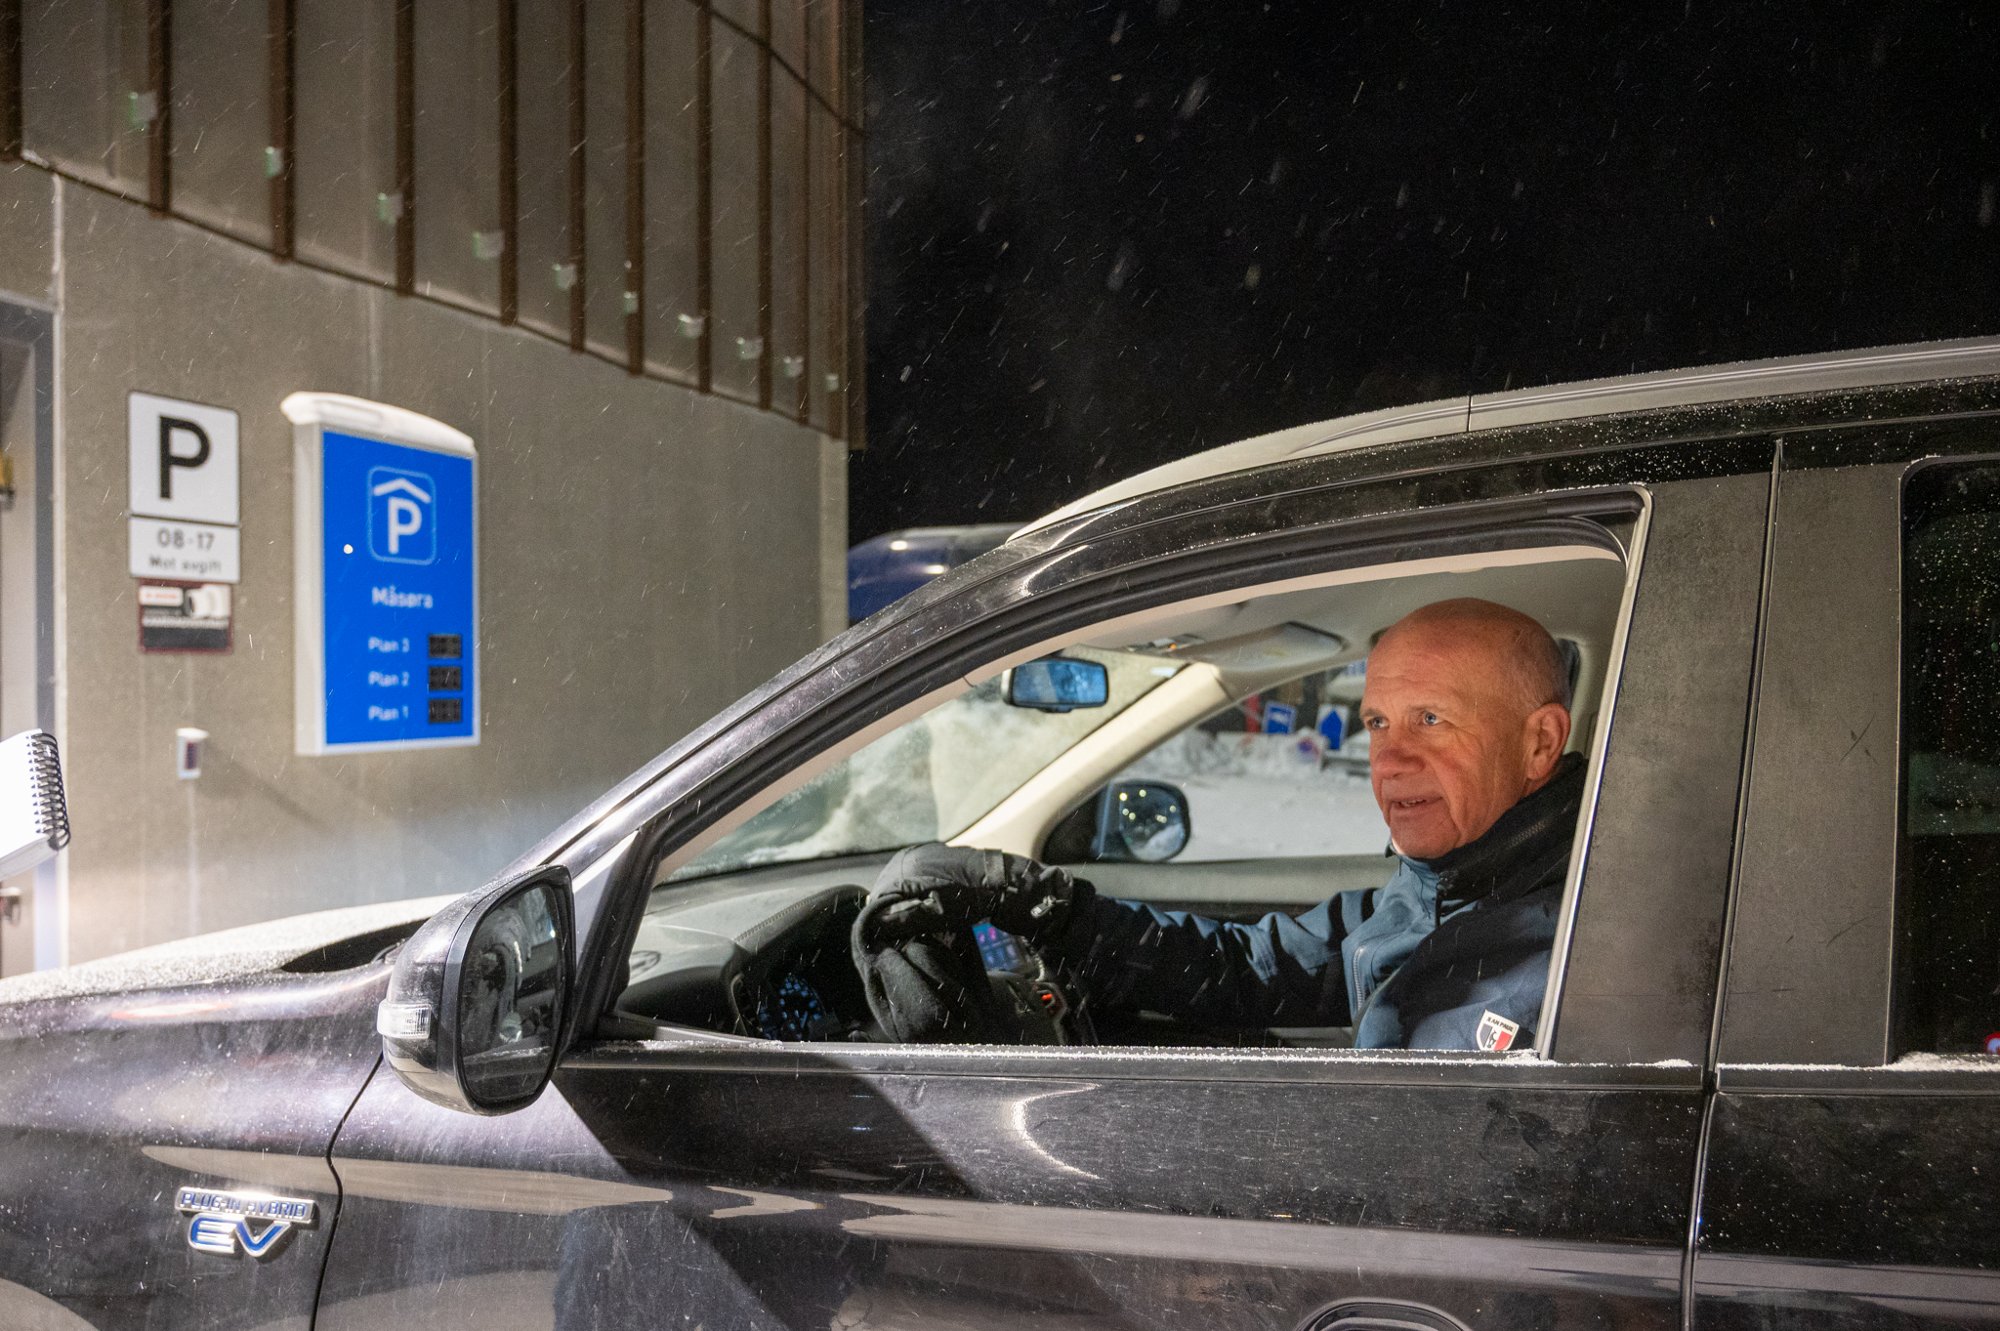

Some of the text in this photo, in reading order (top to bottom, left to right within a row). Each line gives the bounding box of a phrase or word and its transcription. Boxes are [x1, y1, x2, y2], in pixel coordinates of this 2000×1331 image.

[158, 415, 211, 499] P
[387, 497, 422, 554] P
[368, 636, 399, 653] Plan
[368, 671, 410, 687] Plan 2
[368, 705, 409, 721] Plan 1
[180, 1192, 240, 1214] PLUG-IN
[188, 1213, 291, 1257] EV
